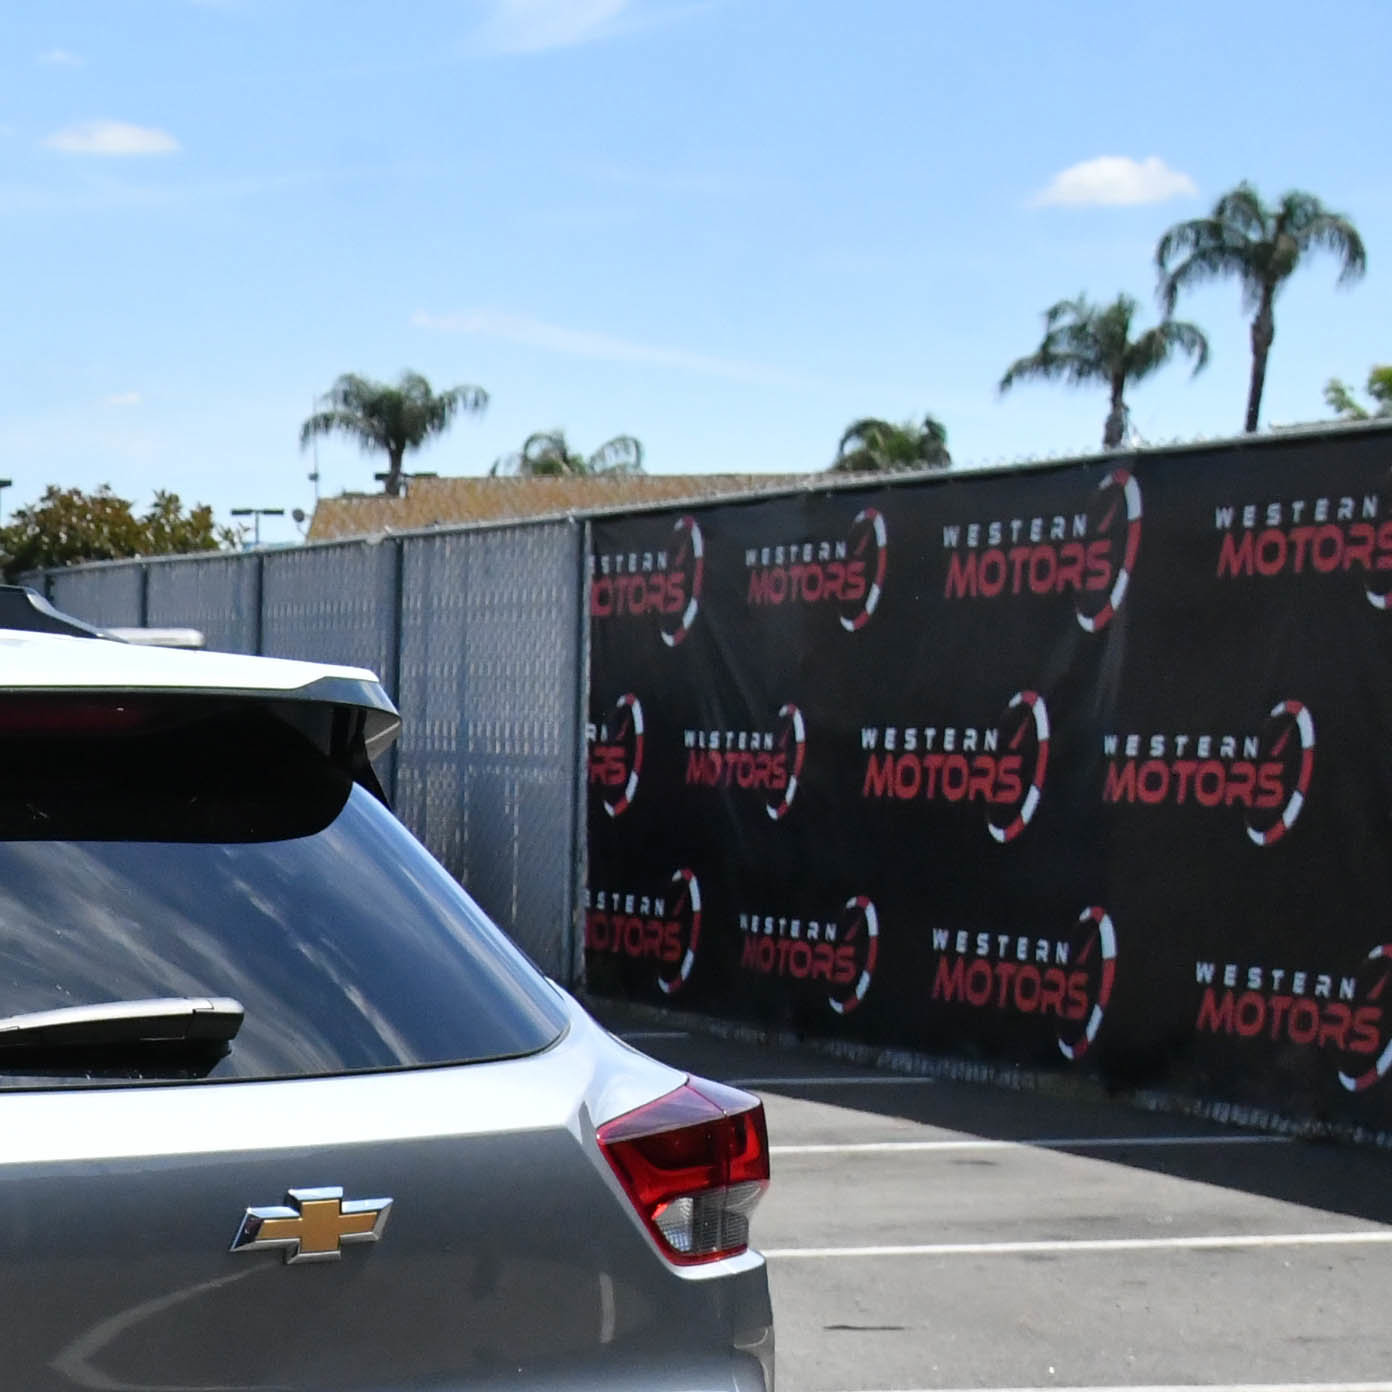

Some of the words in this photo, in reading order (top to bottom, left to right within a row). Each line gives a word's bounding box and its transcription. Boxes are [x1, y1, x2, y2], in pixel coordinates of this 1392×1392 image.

[943, 514, 1087, 548] WESTERN
[1216, 496, 1378, 530] WESTERN
[745, 541, 846, 566] WESTERN
[945, 540, 1112, 599] MOTORS
[1217, 523, 1392, 577] MOTORS
[591, 572, 685, 616] OTORS
[747, 562, 866, 605] MOTORS
[861, 727, 999, 751] WESTERN
[1103, 734, 1259, 759] WESTERN
[685, 749, 787, 790] MOTORS
[862, 754, 1024, 804] MOTORS
[1103, 759, 1284, 808] MOTORS
[584, 911, 681, 961] OTORS
[739, 913, 837, 941] WESTERN
[932, 927, 1069, 966] WESTERN
[741, 935, 856, 984] MOTORS
[1195, 961, 1356, 1000] WESTERN
[932, 956, 1090, 1020] MOTORS
[1196, 987, 1383, 1054] MOTORS
